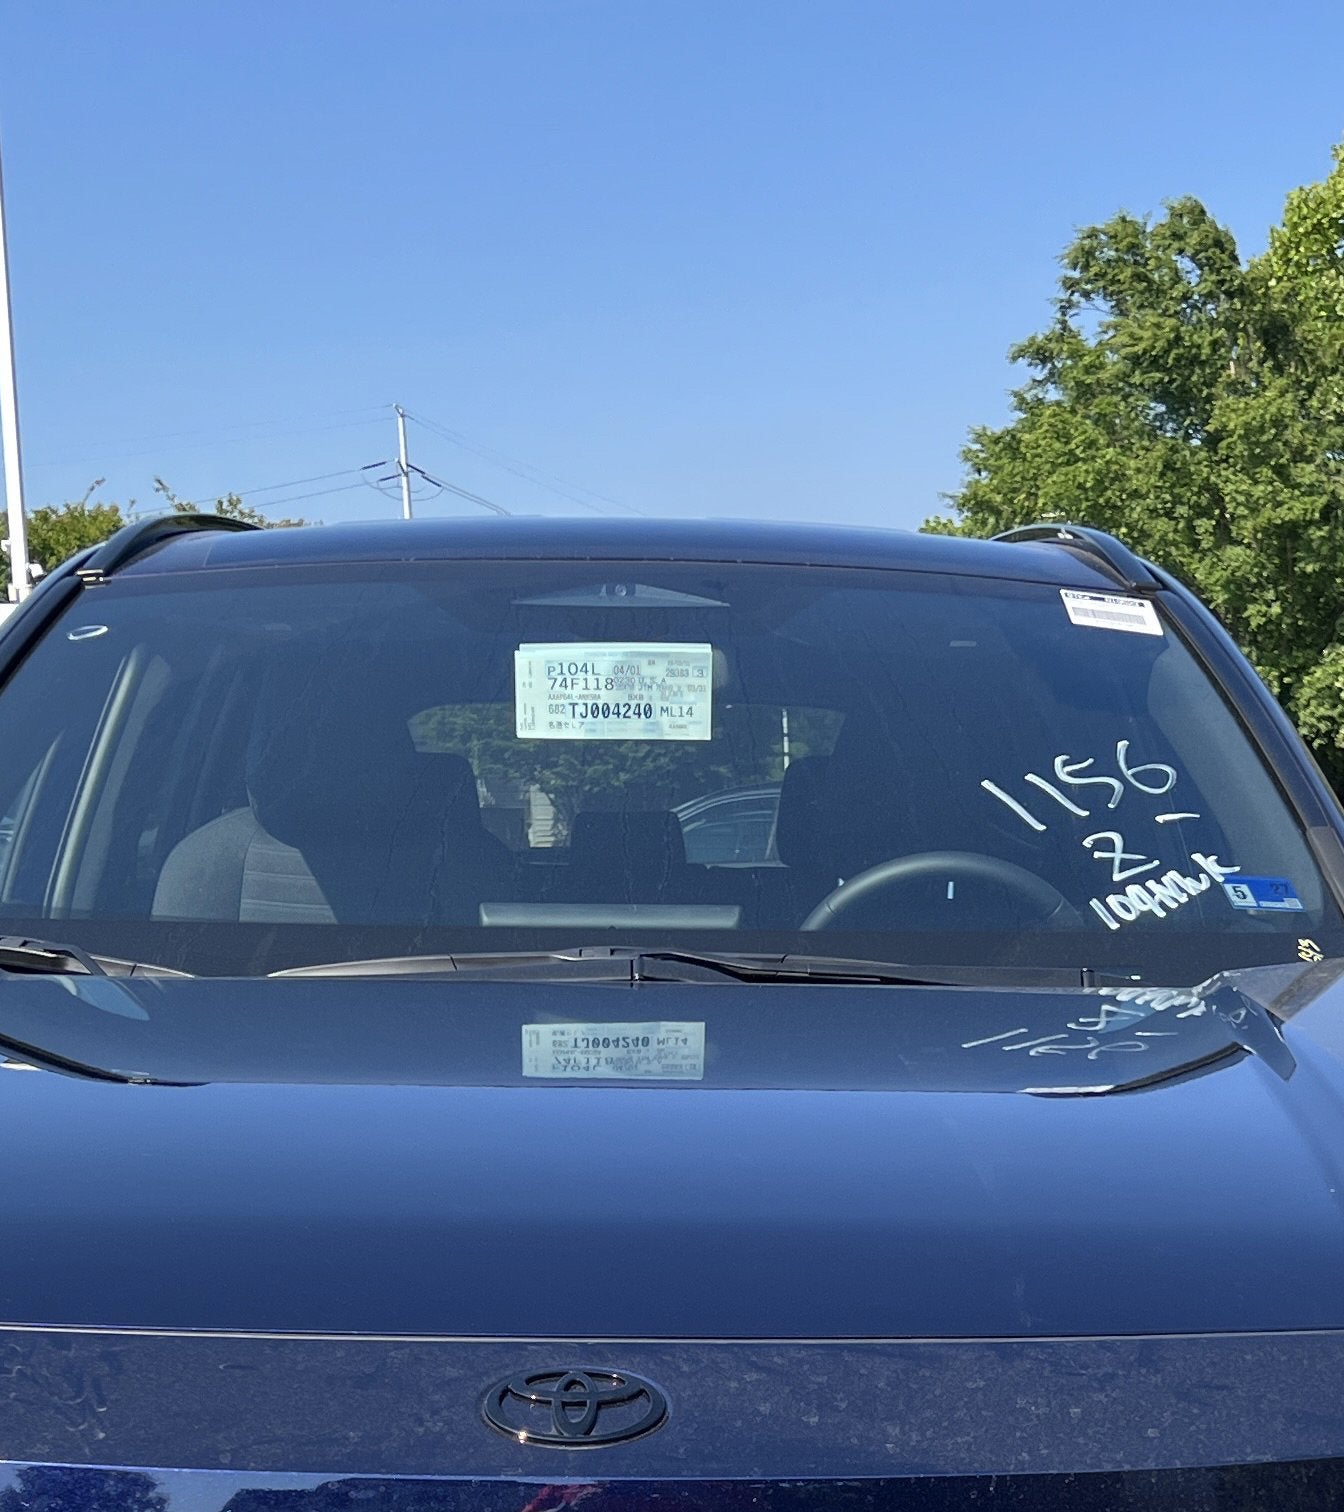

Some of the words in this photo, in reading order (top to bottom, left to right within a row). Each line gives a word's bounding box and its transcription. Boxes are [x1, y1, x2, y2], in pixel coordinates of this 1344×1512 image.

[547, 677, 614, 691] 74F118
[568, 702, 653, 719] TJ004240
[660, 705, 694, 718] ML14
[1231, 885, 1248, 900] 5
